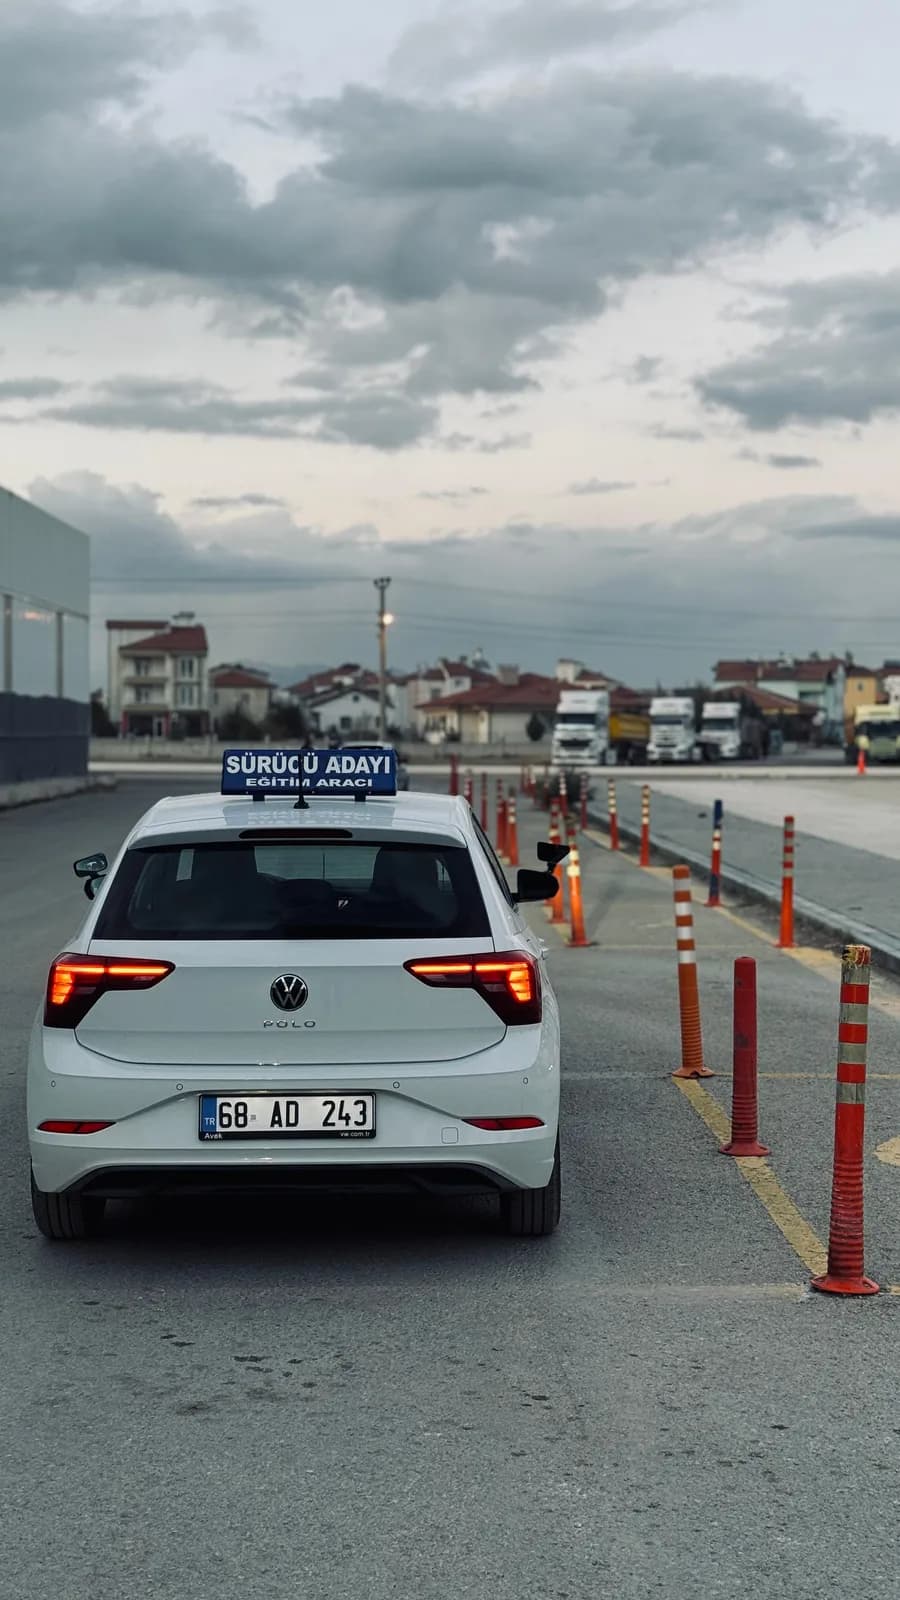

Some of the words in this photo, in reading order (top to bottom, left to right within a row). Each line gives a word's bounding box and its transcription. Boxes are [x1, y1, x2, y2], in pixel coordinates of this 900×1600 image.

[226, 752, 319, 774] SÜRÜCÜ
[325, 756, 390, 774] ADAYI
[245, 776, 310, 787] EĞİTİM
[316, 778, 373, 787] ARACI
[263, 1020, 316, 1028] POLO
[219, 1101, 248, 1128] 68
[270, 1101, 299, 1128] AD
[322, 1099, 367, 1127] 243
[204, 1118, 216, 1126] TR
